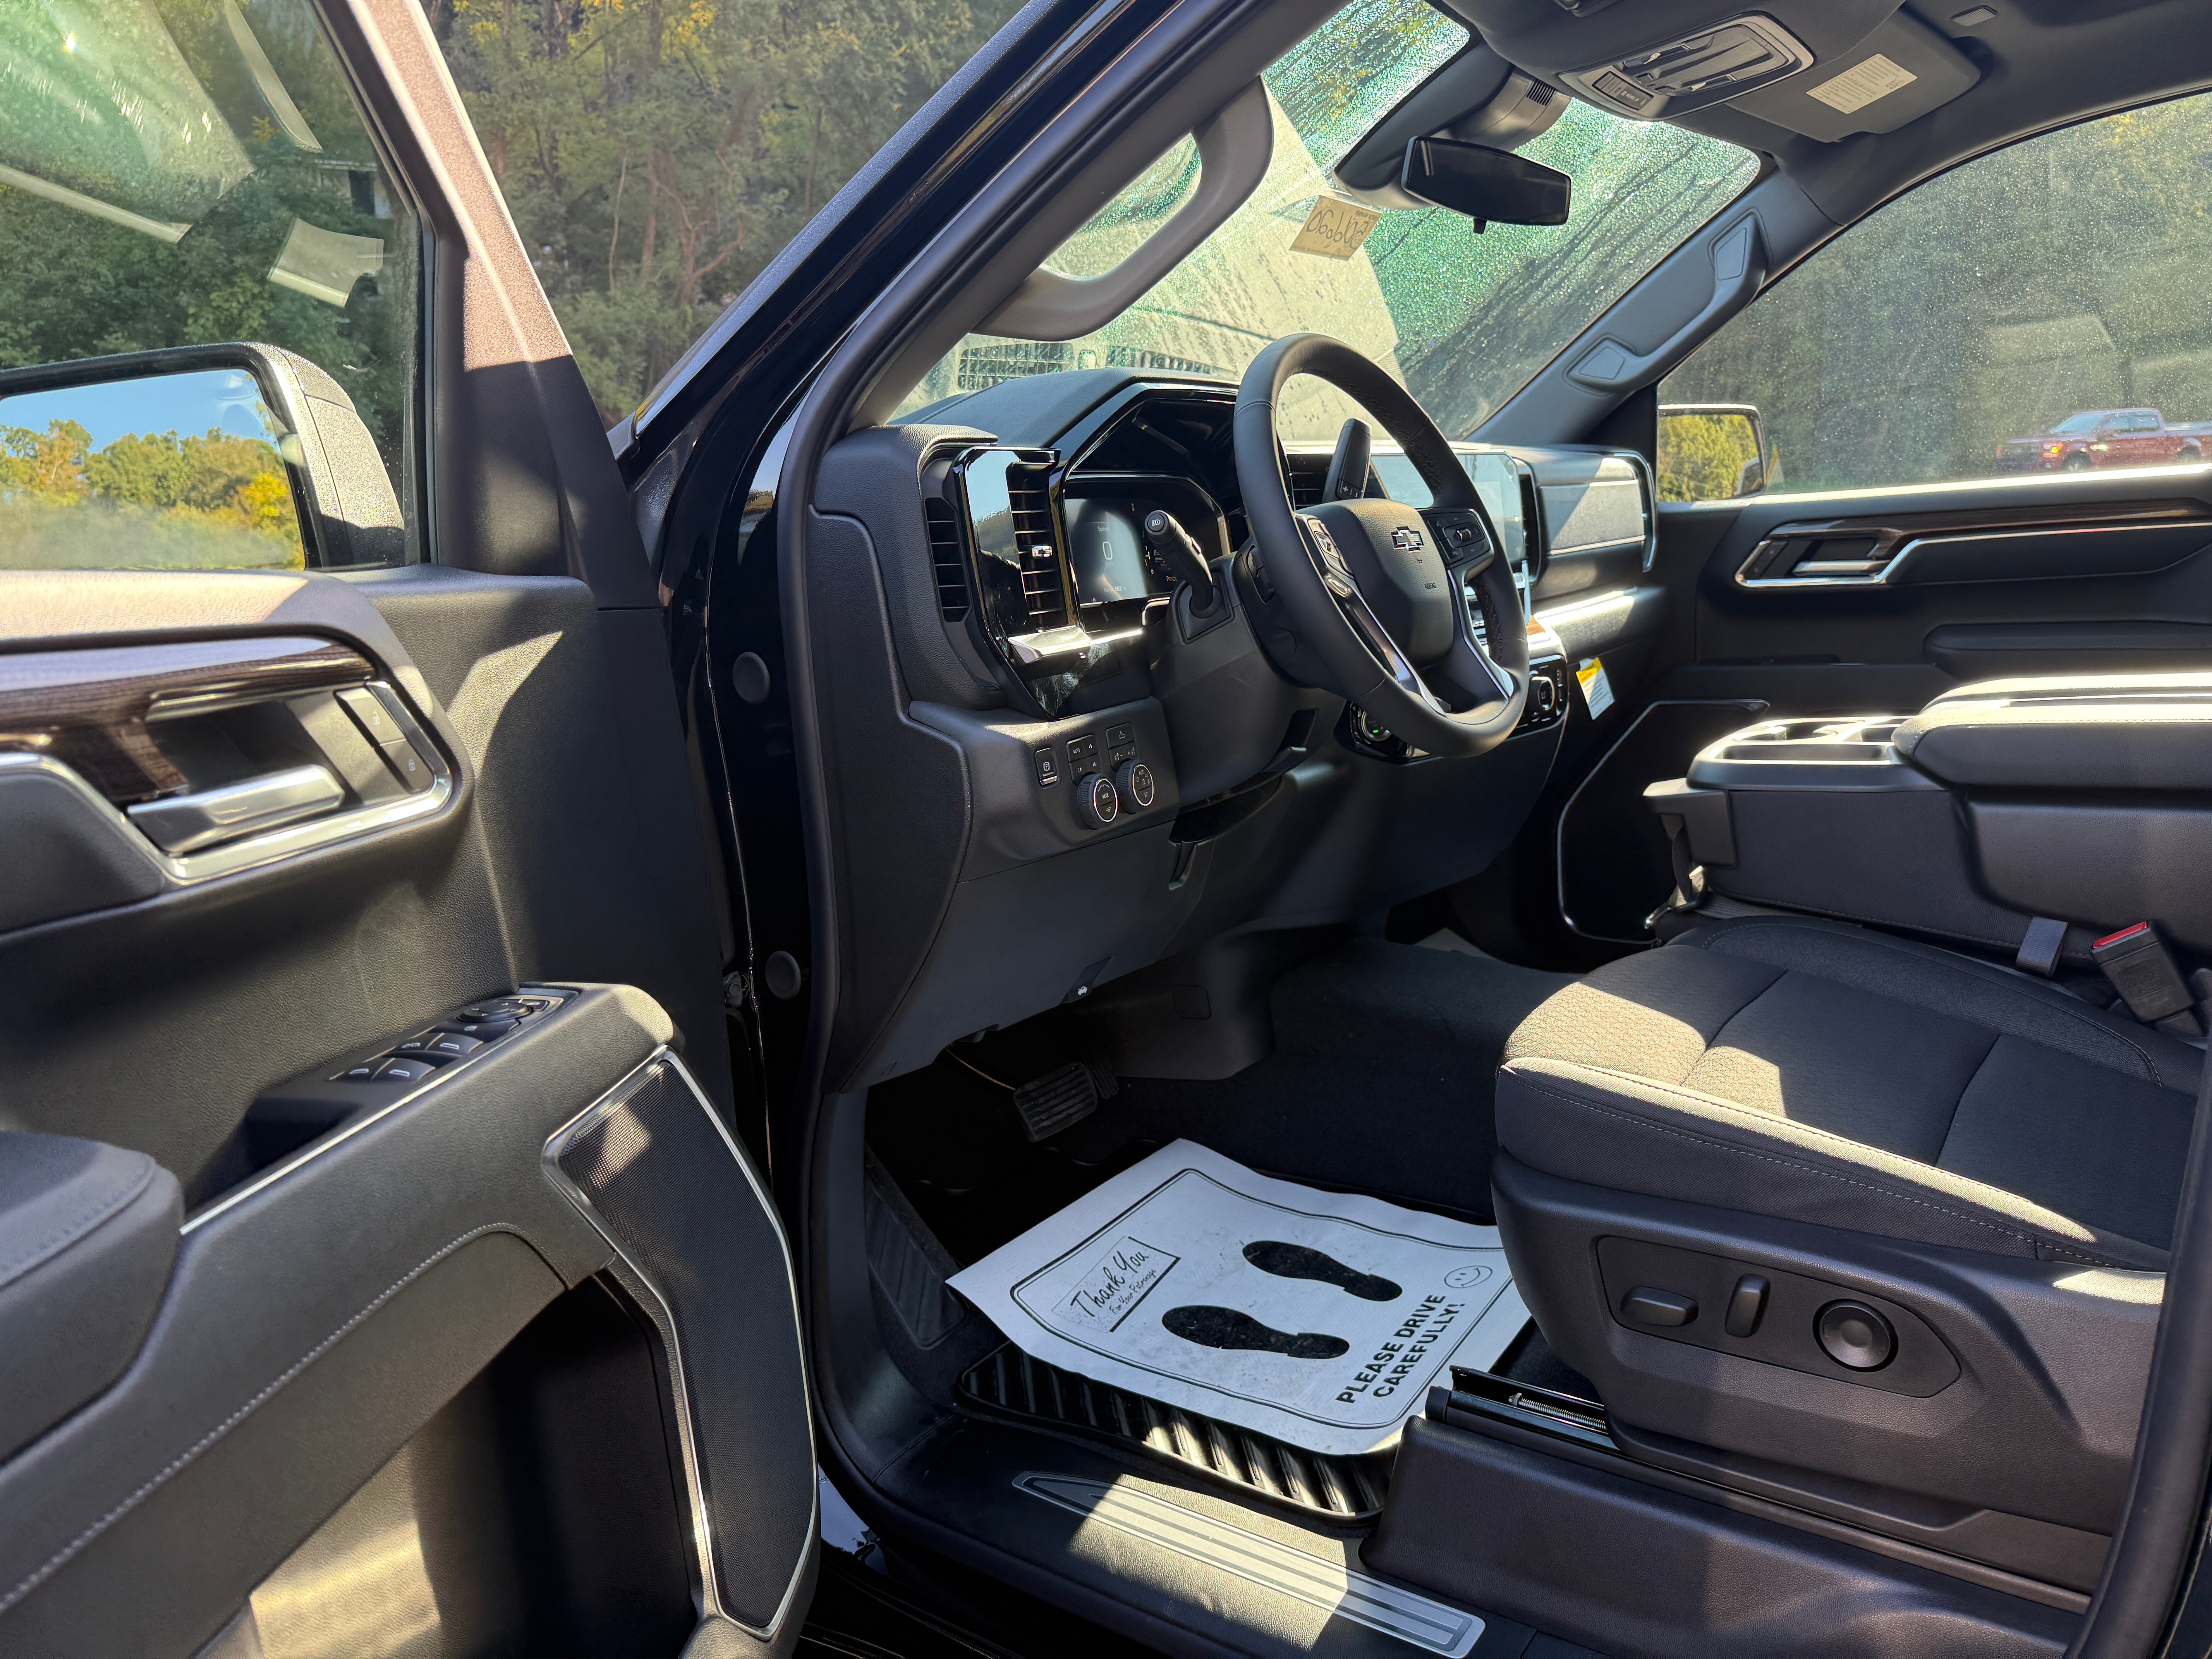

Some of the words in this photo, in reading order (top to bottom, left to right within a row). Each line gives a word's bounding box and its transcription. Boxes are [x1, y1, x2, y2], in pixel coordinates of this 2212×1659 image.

[1102, 541, 1113, 560] 0
[1070, 1266, 1125, 1317] Thank
[1113, 1250, 1149, 1274] You
[1335, 1341, 1405, 1404] PLEASE
[1393, 1295, 1447, 1338] DRIVE
[1372, 1303, 1466, 1398] CAREFULLY!
